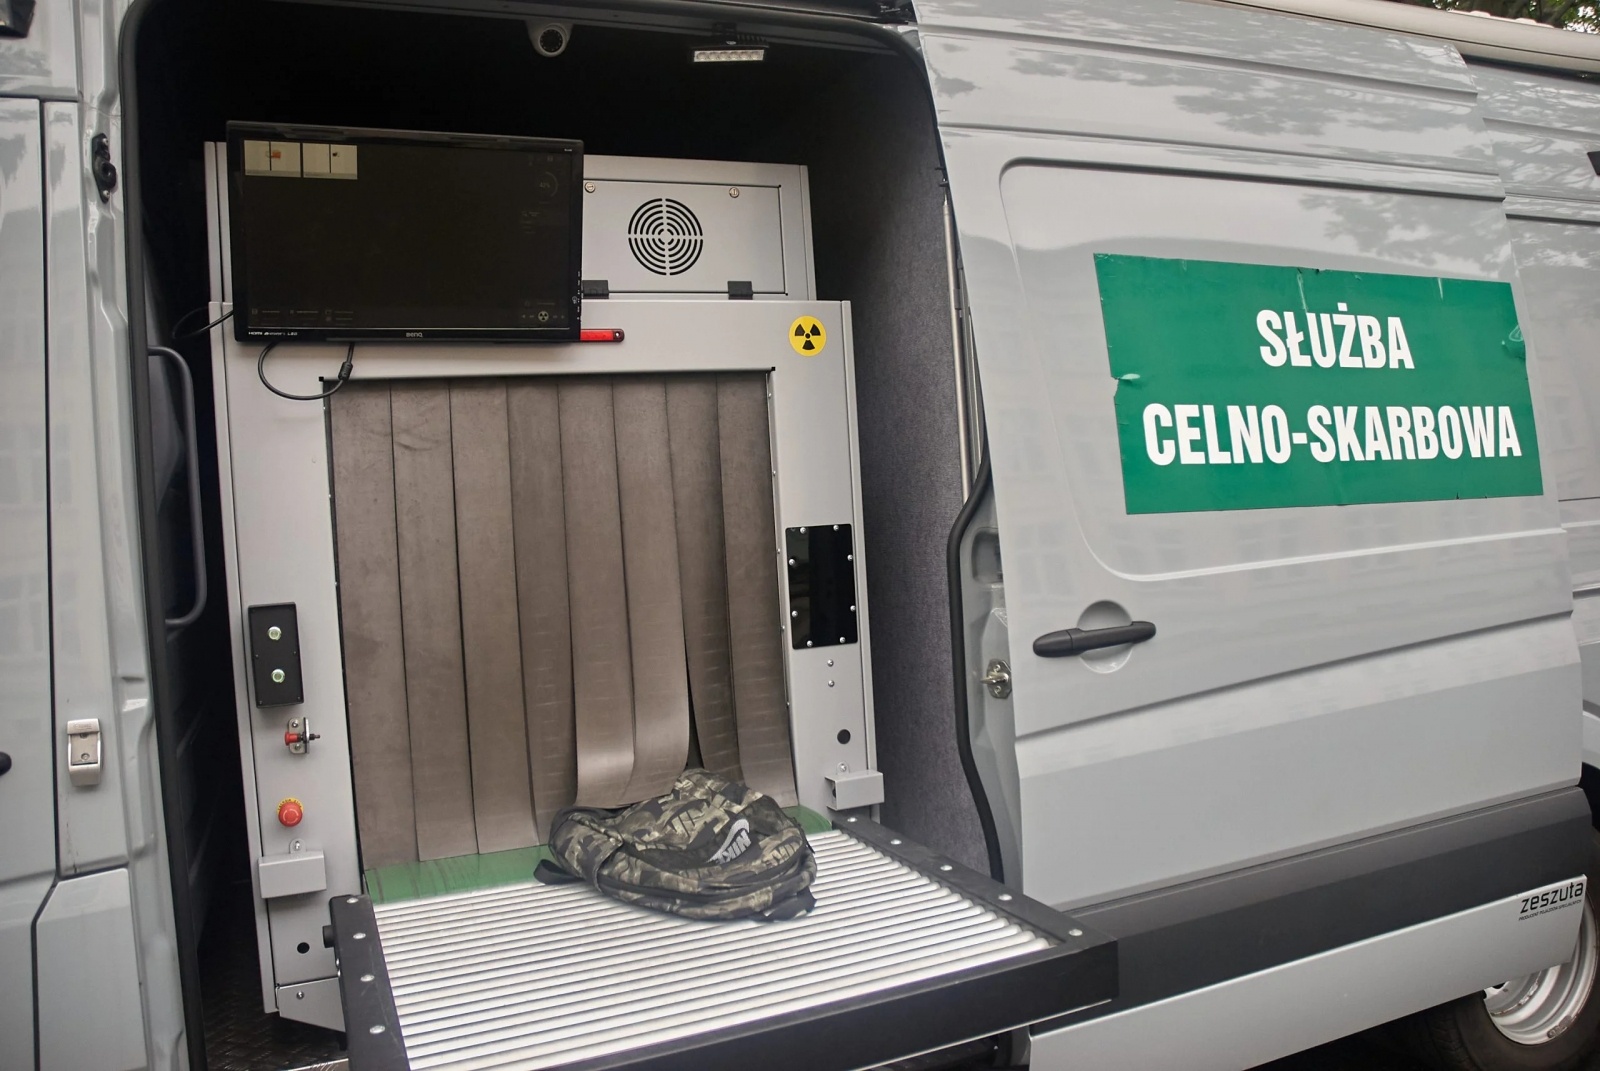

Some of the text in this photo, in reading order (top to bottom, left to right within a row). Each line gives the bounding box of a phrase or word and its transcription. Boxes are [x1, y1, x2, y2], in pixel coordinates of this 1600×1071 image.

[1256, 303, 1414, 370] SŁUŻBA
[1143, 403, 1522, 466] CELNO-SKARBOWA
[1520, 882, 1584, 914] zeszuta
